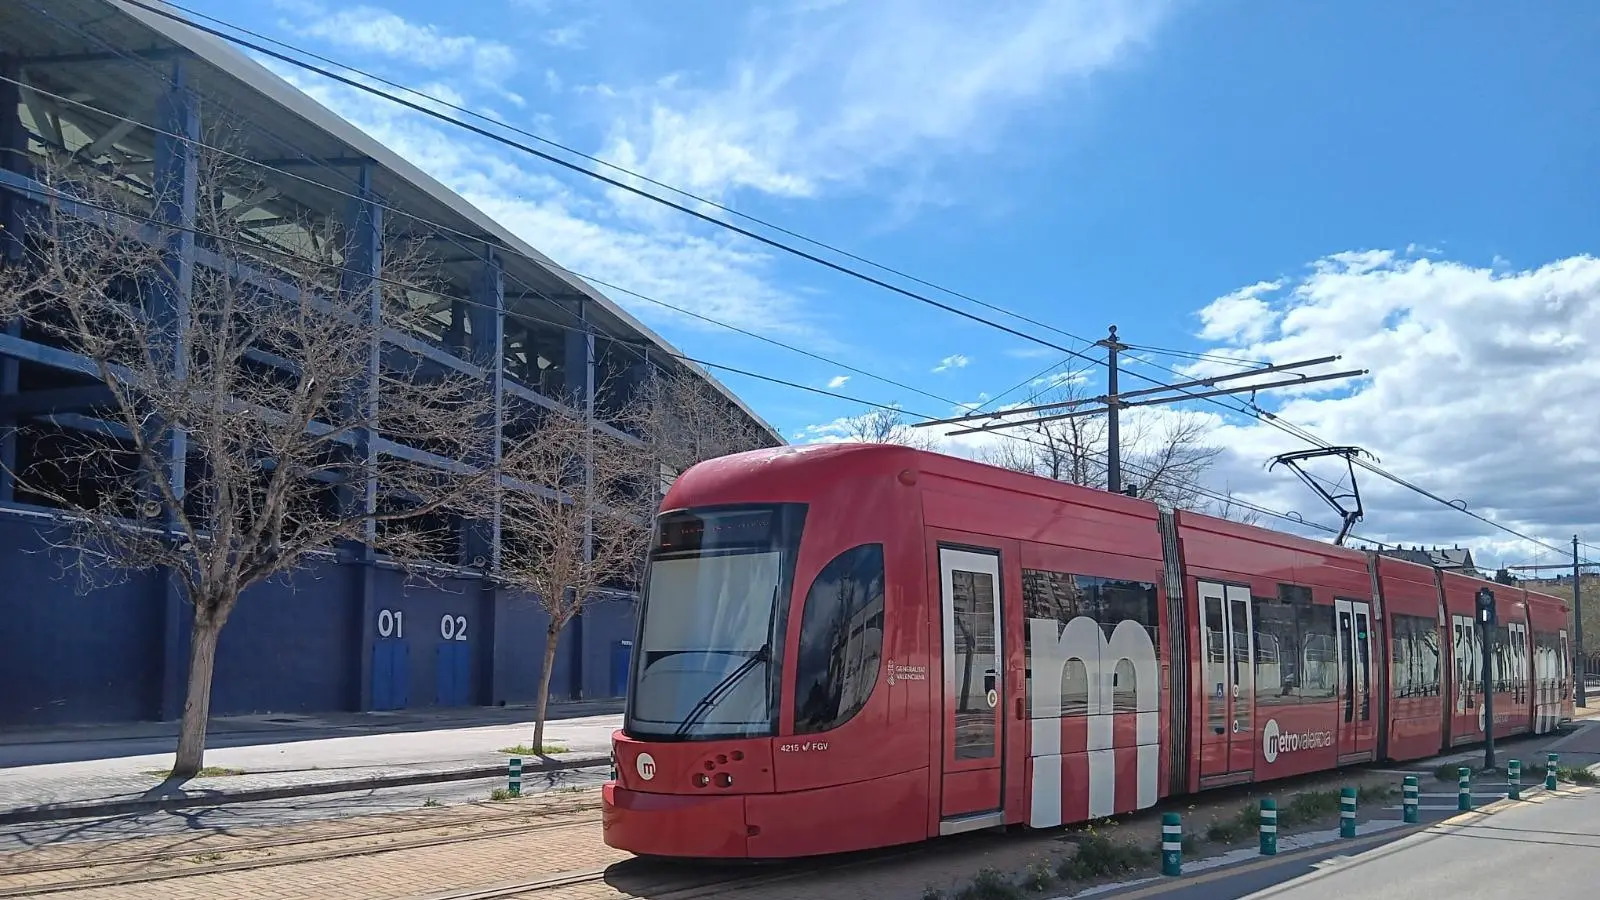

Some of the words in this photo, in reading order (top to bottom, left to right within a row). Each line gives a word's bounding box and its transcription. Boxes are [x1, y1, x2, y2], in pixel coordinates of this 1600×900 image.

[378, 609, 402, 638] 01
[441, 614, 467, 641] 02
[780, 744, 800, 752] 4215
[812, 742, 829, 751] FGV
[643, 763, 655, 775] m
